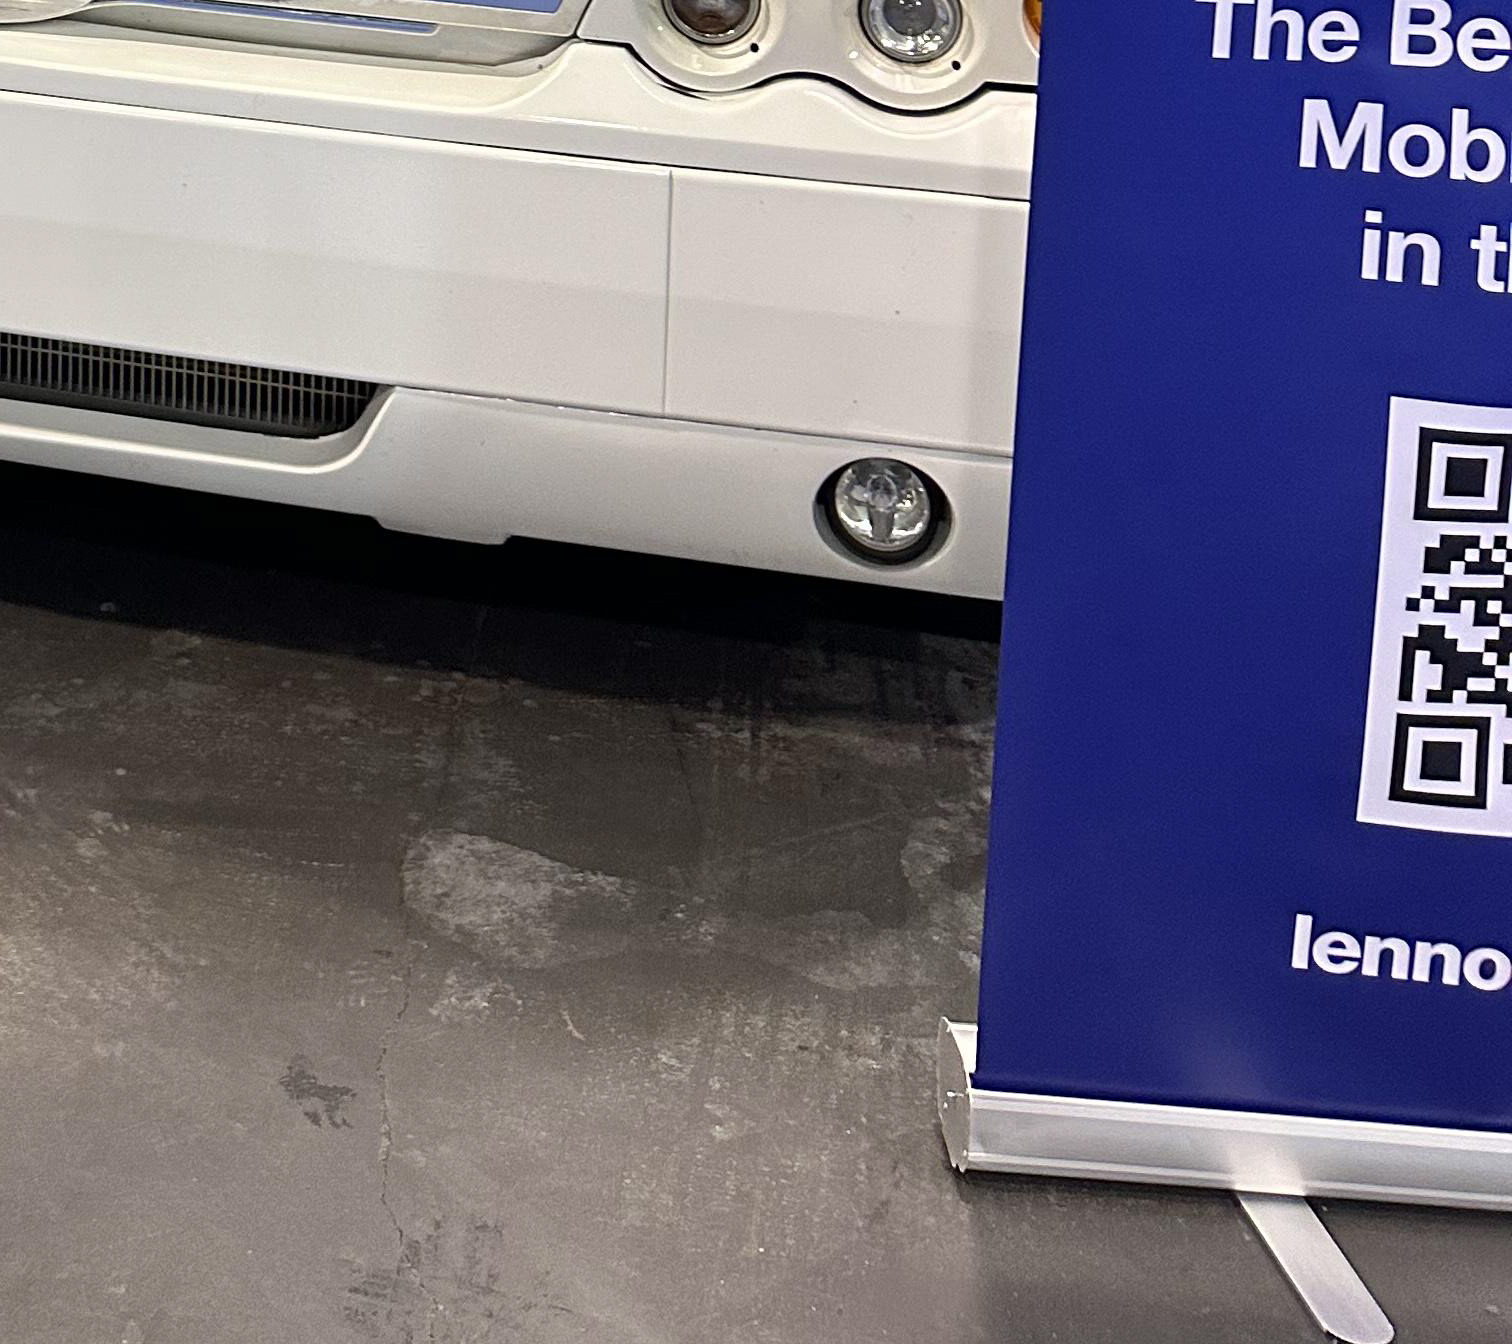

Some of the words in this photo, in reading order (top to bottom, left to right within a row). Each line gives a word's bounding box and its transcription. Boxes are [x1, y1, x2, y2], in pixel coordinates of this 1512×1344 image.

[1299, 98, 1512, 184] Mob
[1361, 209, 1442, 287] in
[1470, 224, 1512, 294] t
